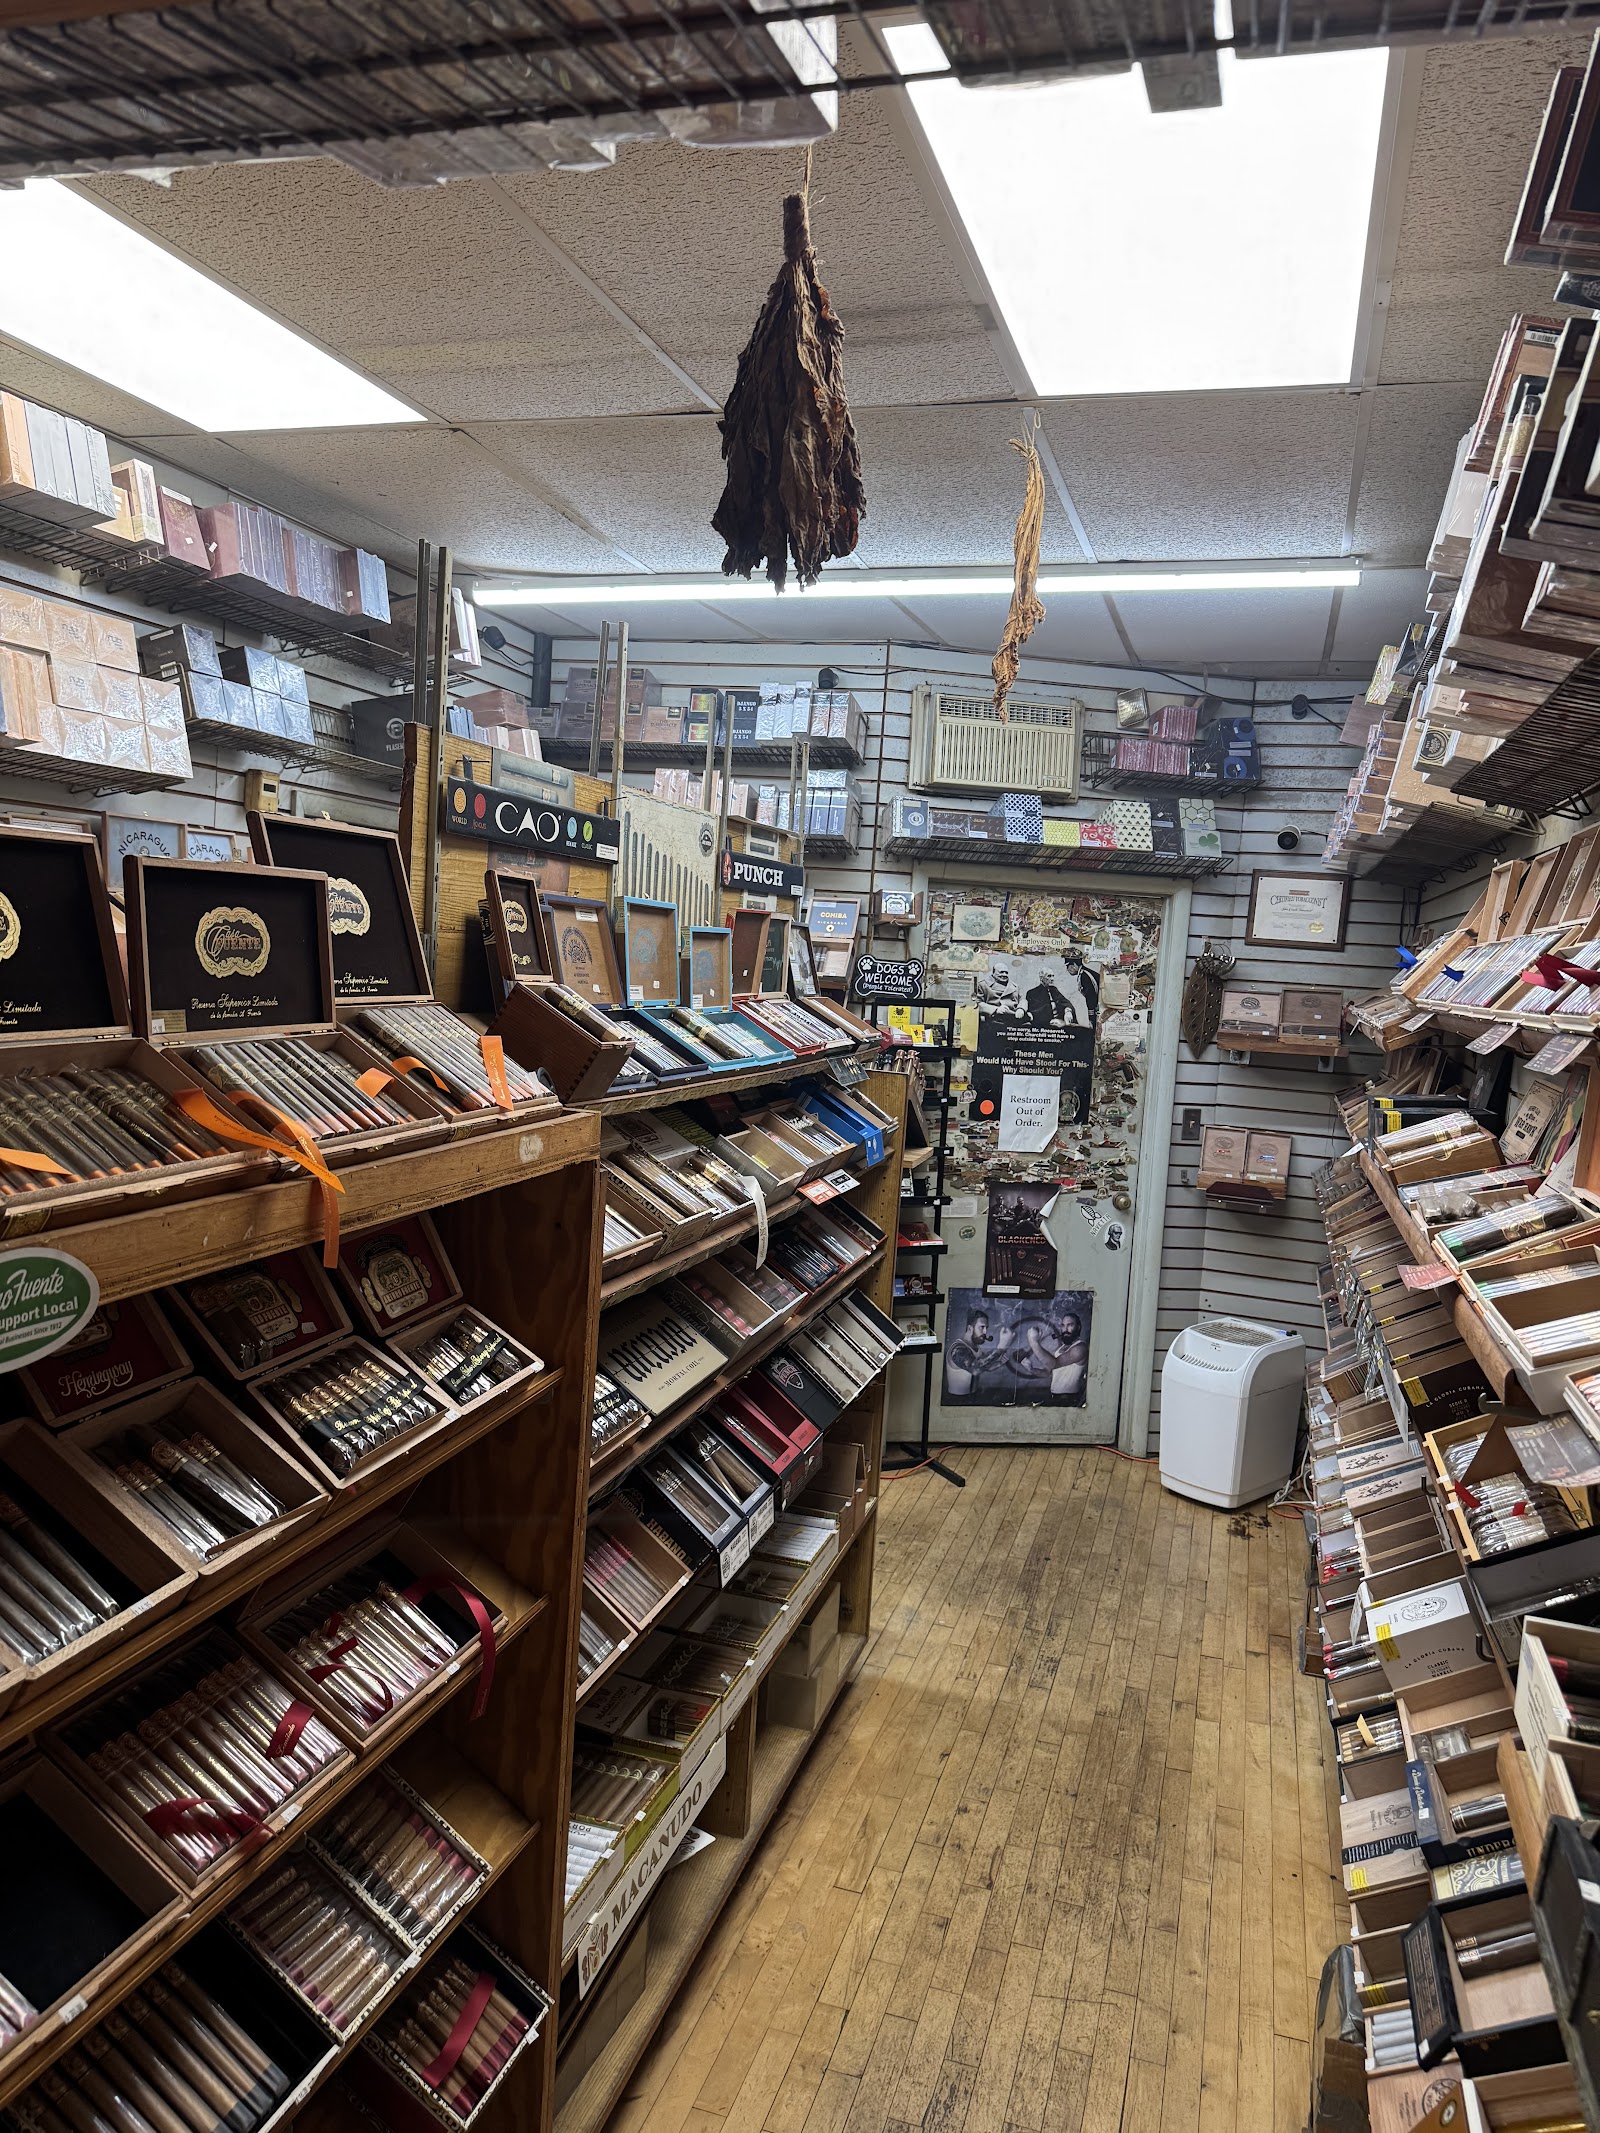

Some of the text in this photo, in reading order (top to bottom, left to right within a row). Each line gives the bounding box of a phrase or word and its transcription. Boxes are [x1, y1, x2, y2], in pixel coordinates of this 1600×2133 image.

[452, 815, 468, 825] WORLD
[495, 801, 560, 843] CAO
[187, 843, 228, 862] ICARAGU
[734, 861, 784, 887] PUNCH
[820, 911, 848, 919] COHIBA
[1016, 937, 1067, 947] Employees Only
[876, 963, 905, 975] DOGS
[864, 972, 913, 987] WELCOME
[3, 1001, 42, 1013] Limitada
[217, 993, 252, 1012] Superior
[1014, 1050, 1037, 1058] These
[976, 1056, 999, 1064] Would
[1001, 1057, 1014, 1065] Not
[1015, 1058, 1034, 1066] Have
[1036, 1059, 1057, 1067] Stood
[1002, 1065, 1064, 1075] Why Should You?
[1010, 1095, 1051, 1105] Restroom
[1016, 1106, 1045, 1116] Out of
[1015, 1117, 1043, 1128] Order.
[998, 1235, 1047, 1245] BLACKENED
[7, 1269, 64, 1305] Fuente
[0, 1296, 79, 1331] upport Local
[5, 1330, 33, 1344] Businesses
[33, 1325, 48, 1335] Since
[49, 1321, 62, 1330] 1912
[58, 1361, 134, 1398] Hemingway
[1434, 1389, 1456, 1402] GLORIA
[1413, 1651, 1435, 1663] GLORIA
[1427, 1659, 1449, 1670] CLASSIC
[611, 1780, 703, 1933] MACANUDO
